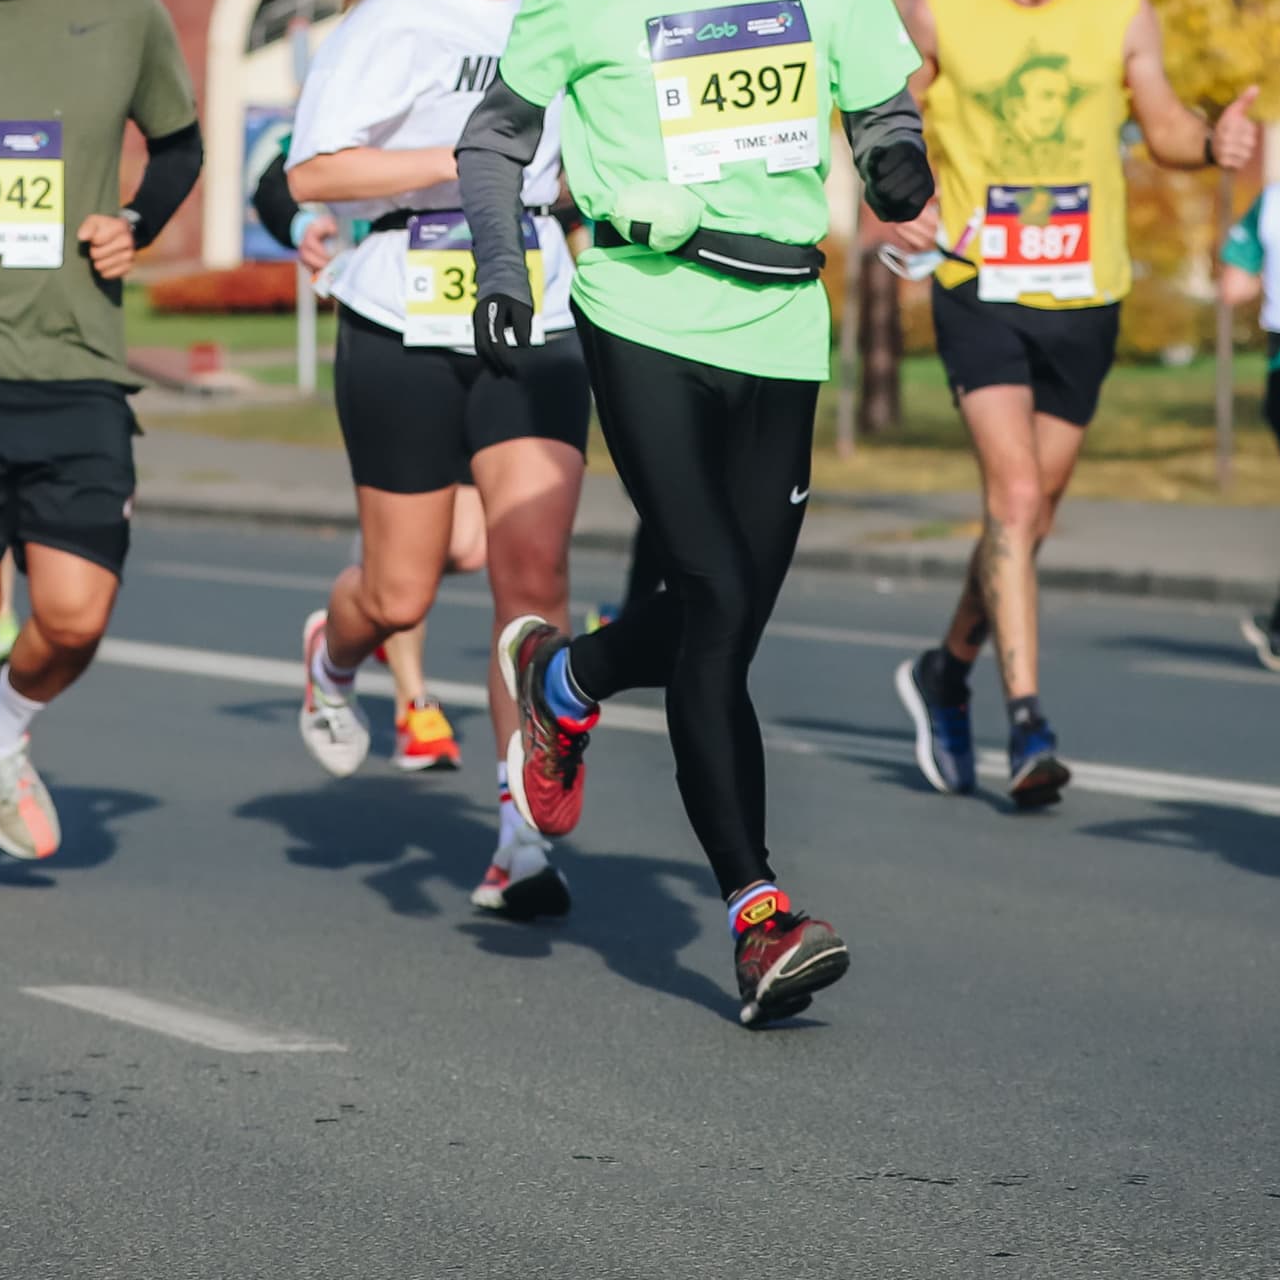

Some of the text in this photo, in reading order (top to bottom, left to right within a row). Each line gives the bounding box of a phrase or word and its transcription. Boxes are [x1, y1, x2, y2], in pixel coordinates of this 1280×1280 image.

[454, 55, 501, 91] NI
[701, 62, 807, 112] 4397
[666, 89, 680, 106] B
